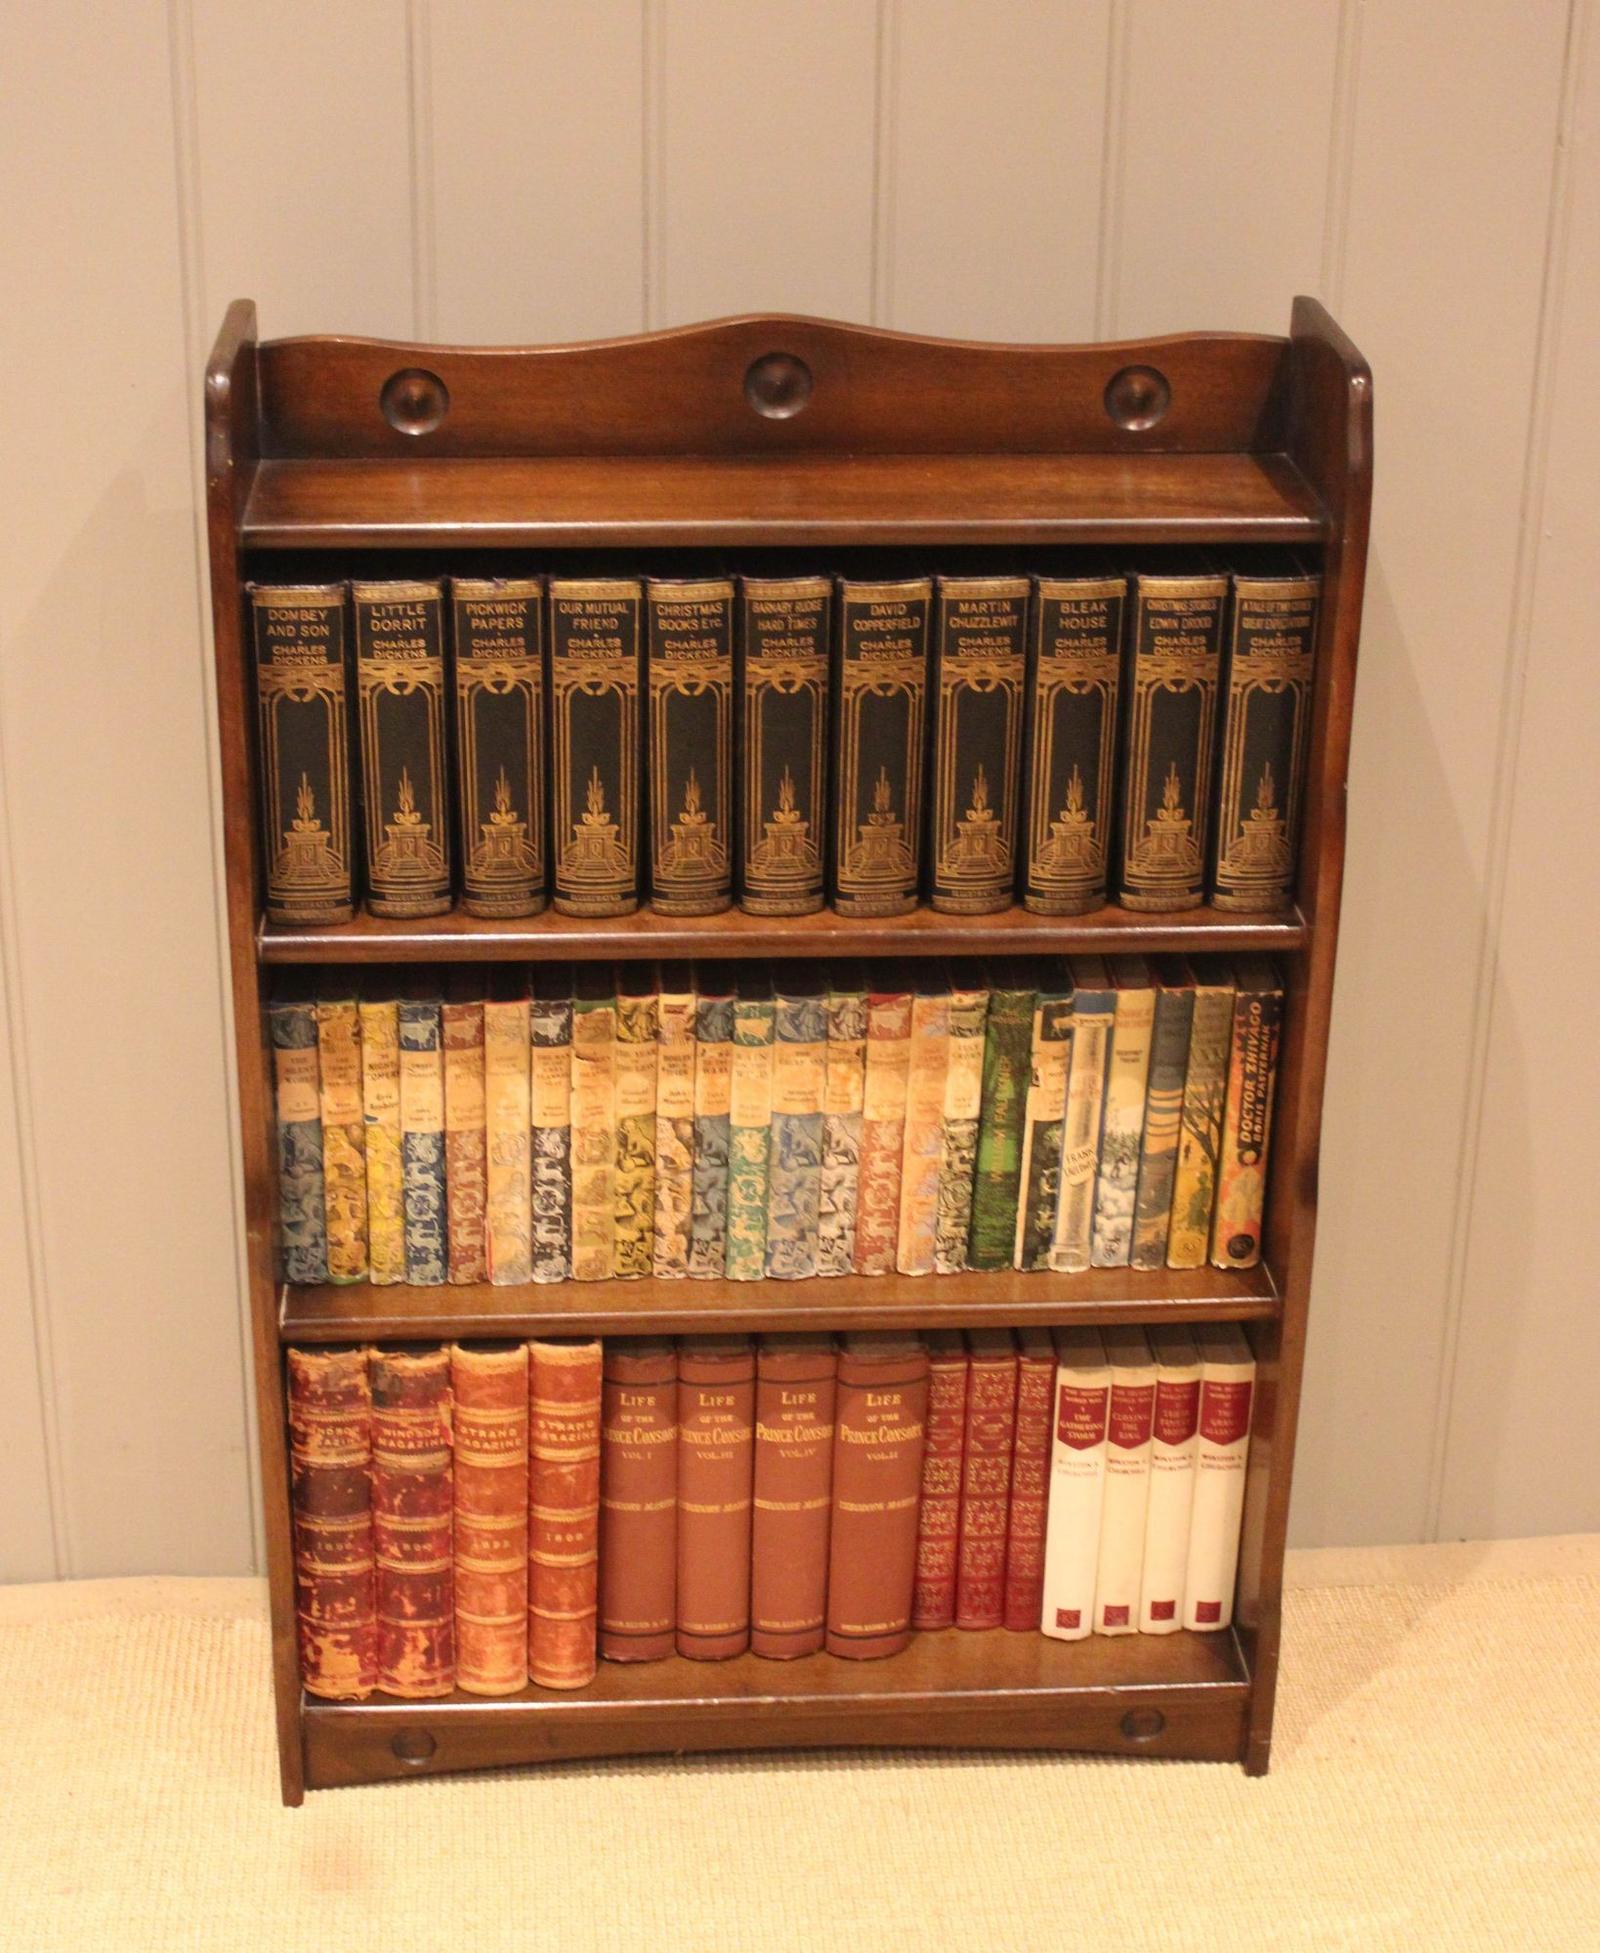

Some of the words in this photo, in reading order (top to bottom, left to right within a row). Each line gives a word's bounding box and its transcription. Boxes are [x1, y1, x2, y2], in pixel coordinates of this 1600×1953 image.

[371, 603, 426, 617] LITTLE
[466, 602, 529, 616] PICKWICK
[559, 603, 584, 615] OUR
[586, 603, 628, 615] MUTUAL
[656, 603, 723, 617] CHRISTMAS
[870, 604, 907, 616] DAVID
[959, 601, 1011, 614] MARTIN
[1060, 602, 1108, 614] BLEAK
[267, 609, 329, 622] DOMBEY
[370, 618, 428, 632] DORRIT
[471, 617, 524, 630] PAPERS
[572, 618, 618, 630] FRIEND
[658, 619, 698, 631] BOOKS
[853, 617, 921, 631] COPPERFIELD
[950, 615, 1018, 629] CHUZZLEWIT
[1059, 616, 1107, 629] HOUSE
[267, 625, 296, 637] AND
[301, 624, 329, 637] SON
[373, 639, 426, 649] CHARLES
[471, 637, 526, 648] CHARLES
[568, 638, 622, 648] CHARLES
[665, 639, 717, 650] CHARLES
[761, 637, 814, 648] CHARLES
[860, 639, 913, 650] CHARLES
[958, 636, 1011, 647] CHARLES
[1055, 637, 1107, 648] CHARLES
[1154, 635, 1206, 646] CHARLES
[272, 645, 327, 655] CHARLES
[373, 649, 428, 659] DICKENS
[472, 648, 527, 658] DICKENS
[568, 648, 623, 658] DICKENS
[665, 649, 718, 660] DICKENS
[761, 648, 815, 658] DICKENS
[859, 650, 913, 661] DICKENS
[958, 647, 1011, 657] DICKENS
[1055, 648, 1107, 658] DICKENS
[1153, 646, 1207, 657] DICKENS
[272, 656, 329, 665] DICKENS
[1245, 1001, 1262, 1073] ZHIVAGO
[1257, 1024, 1270, 1098] PASTERNAK
[1240, 1080, 1256, 1143] DOCTOR
[1253, 1103, 1264, 1142] BORIS
[620, 1393, 657, 1406] LIFE
[699, 1393, 735, 1407] LIFE
[782, 1392, 817, 1405] LIFE
[866, 1393, 903, 1407] LIFE
[635, 1415, 655, 1423] THE
[714, 1414, 734, 1423] THE
[796, 1412, 816, 1421] THE
[881, 1413, 900, 1422] THE
[538, 1420, 595, 1431] STRAND
[383, 1427, 440, 1437] WINDSOR
[460, 1425, 518, 1438] STRAND
[756, 1421, 795, 1443] PRINCE
[840, 1423, 879, 1444] PRINCE
[463, 1438, 522, 1449] AGAZINE
